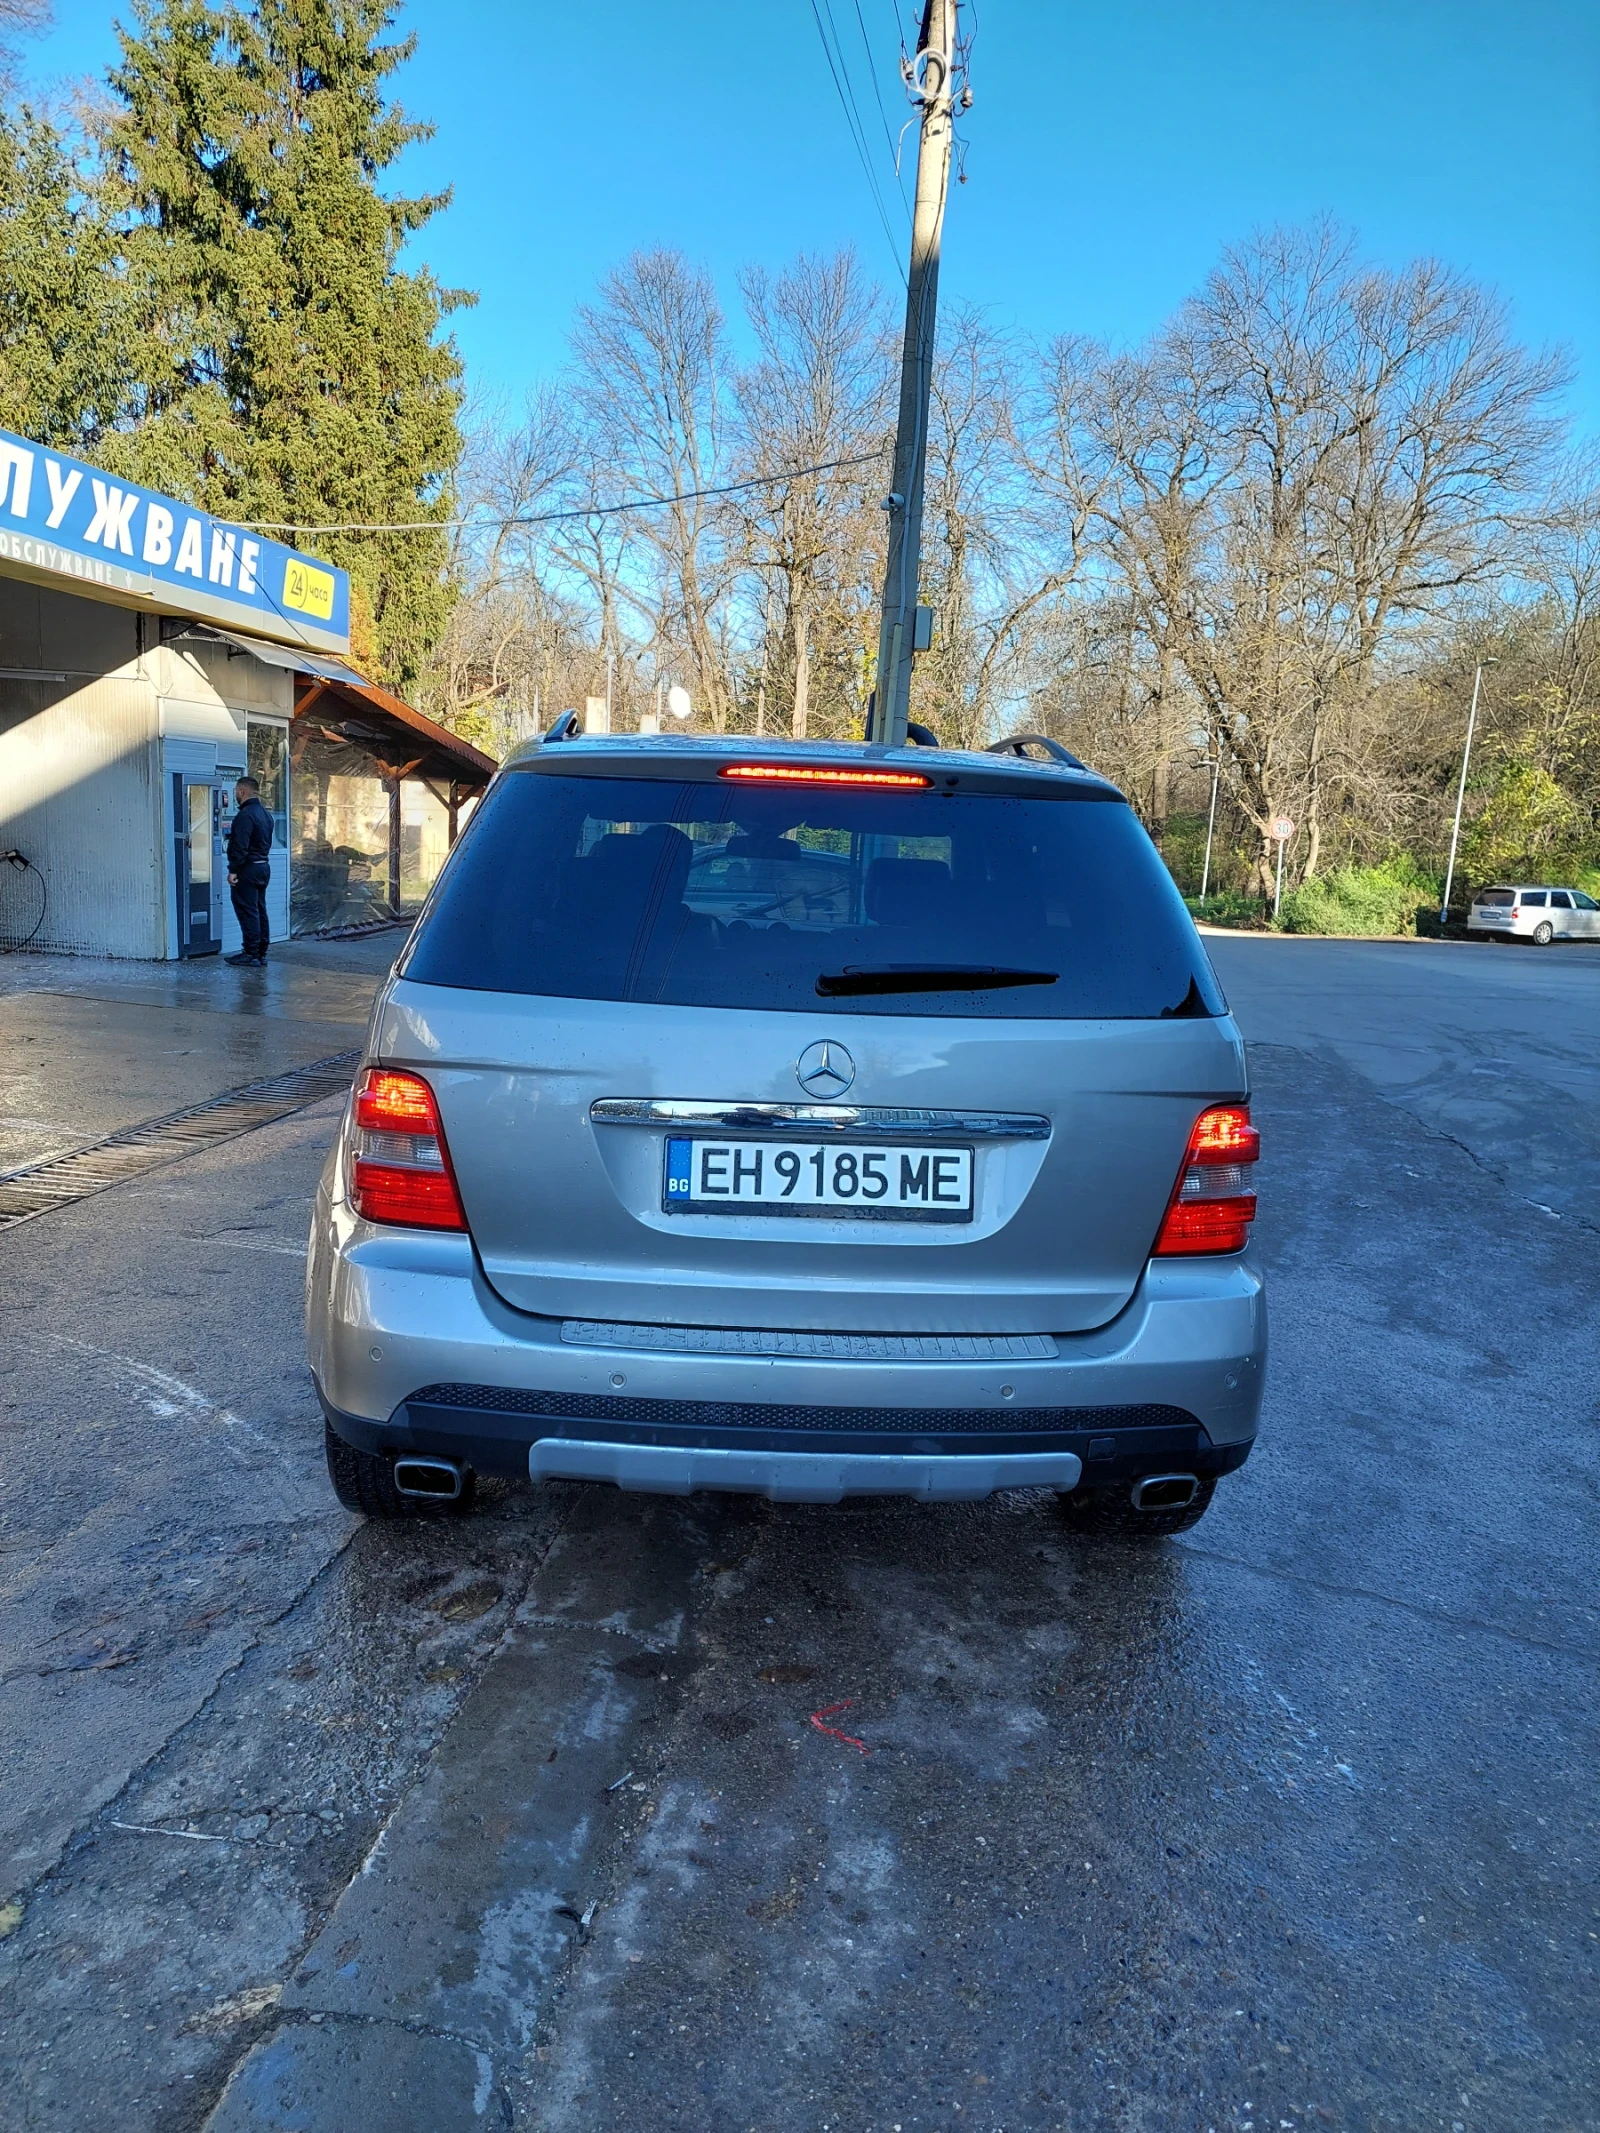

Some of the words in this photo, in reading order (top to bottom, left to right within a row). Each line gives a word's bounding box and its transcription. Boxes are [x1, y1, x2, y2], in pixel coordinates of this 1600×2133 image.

[0, 437, 260, 595] ЛУЖВАНЕ
[0, 533, 113, 584] ОБСЛУЖВАНЕ
[290, 570, 303, 597] 24
[309, 585, 328, 602] часа
[1276, 823, 1289, 834] 30
[669, 1178, 689, 1193] BG
[701, 1148, 763, 1195] EH
[774, 1150, 888, 1199] 9185
[900, 1154, 961, 1202] ME
